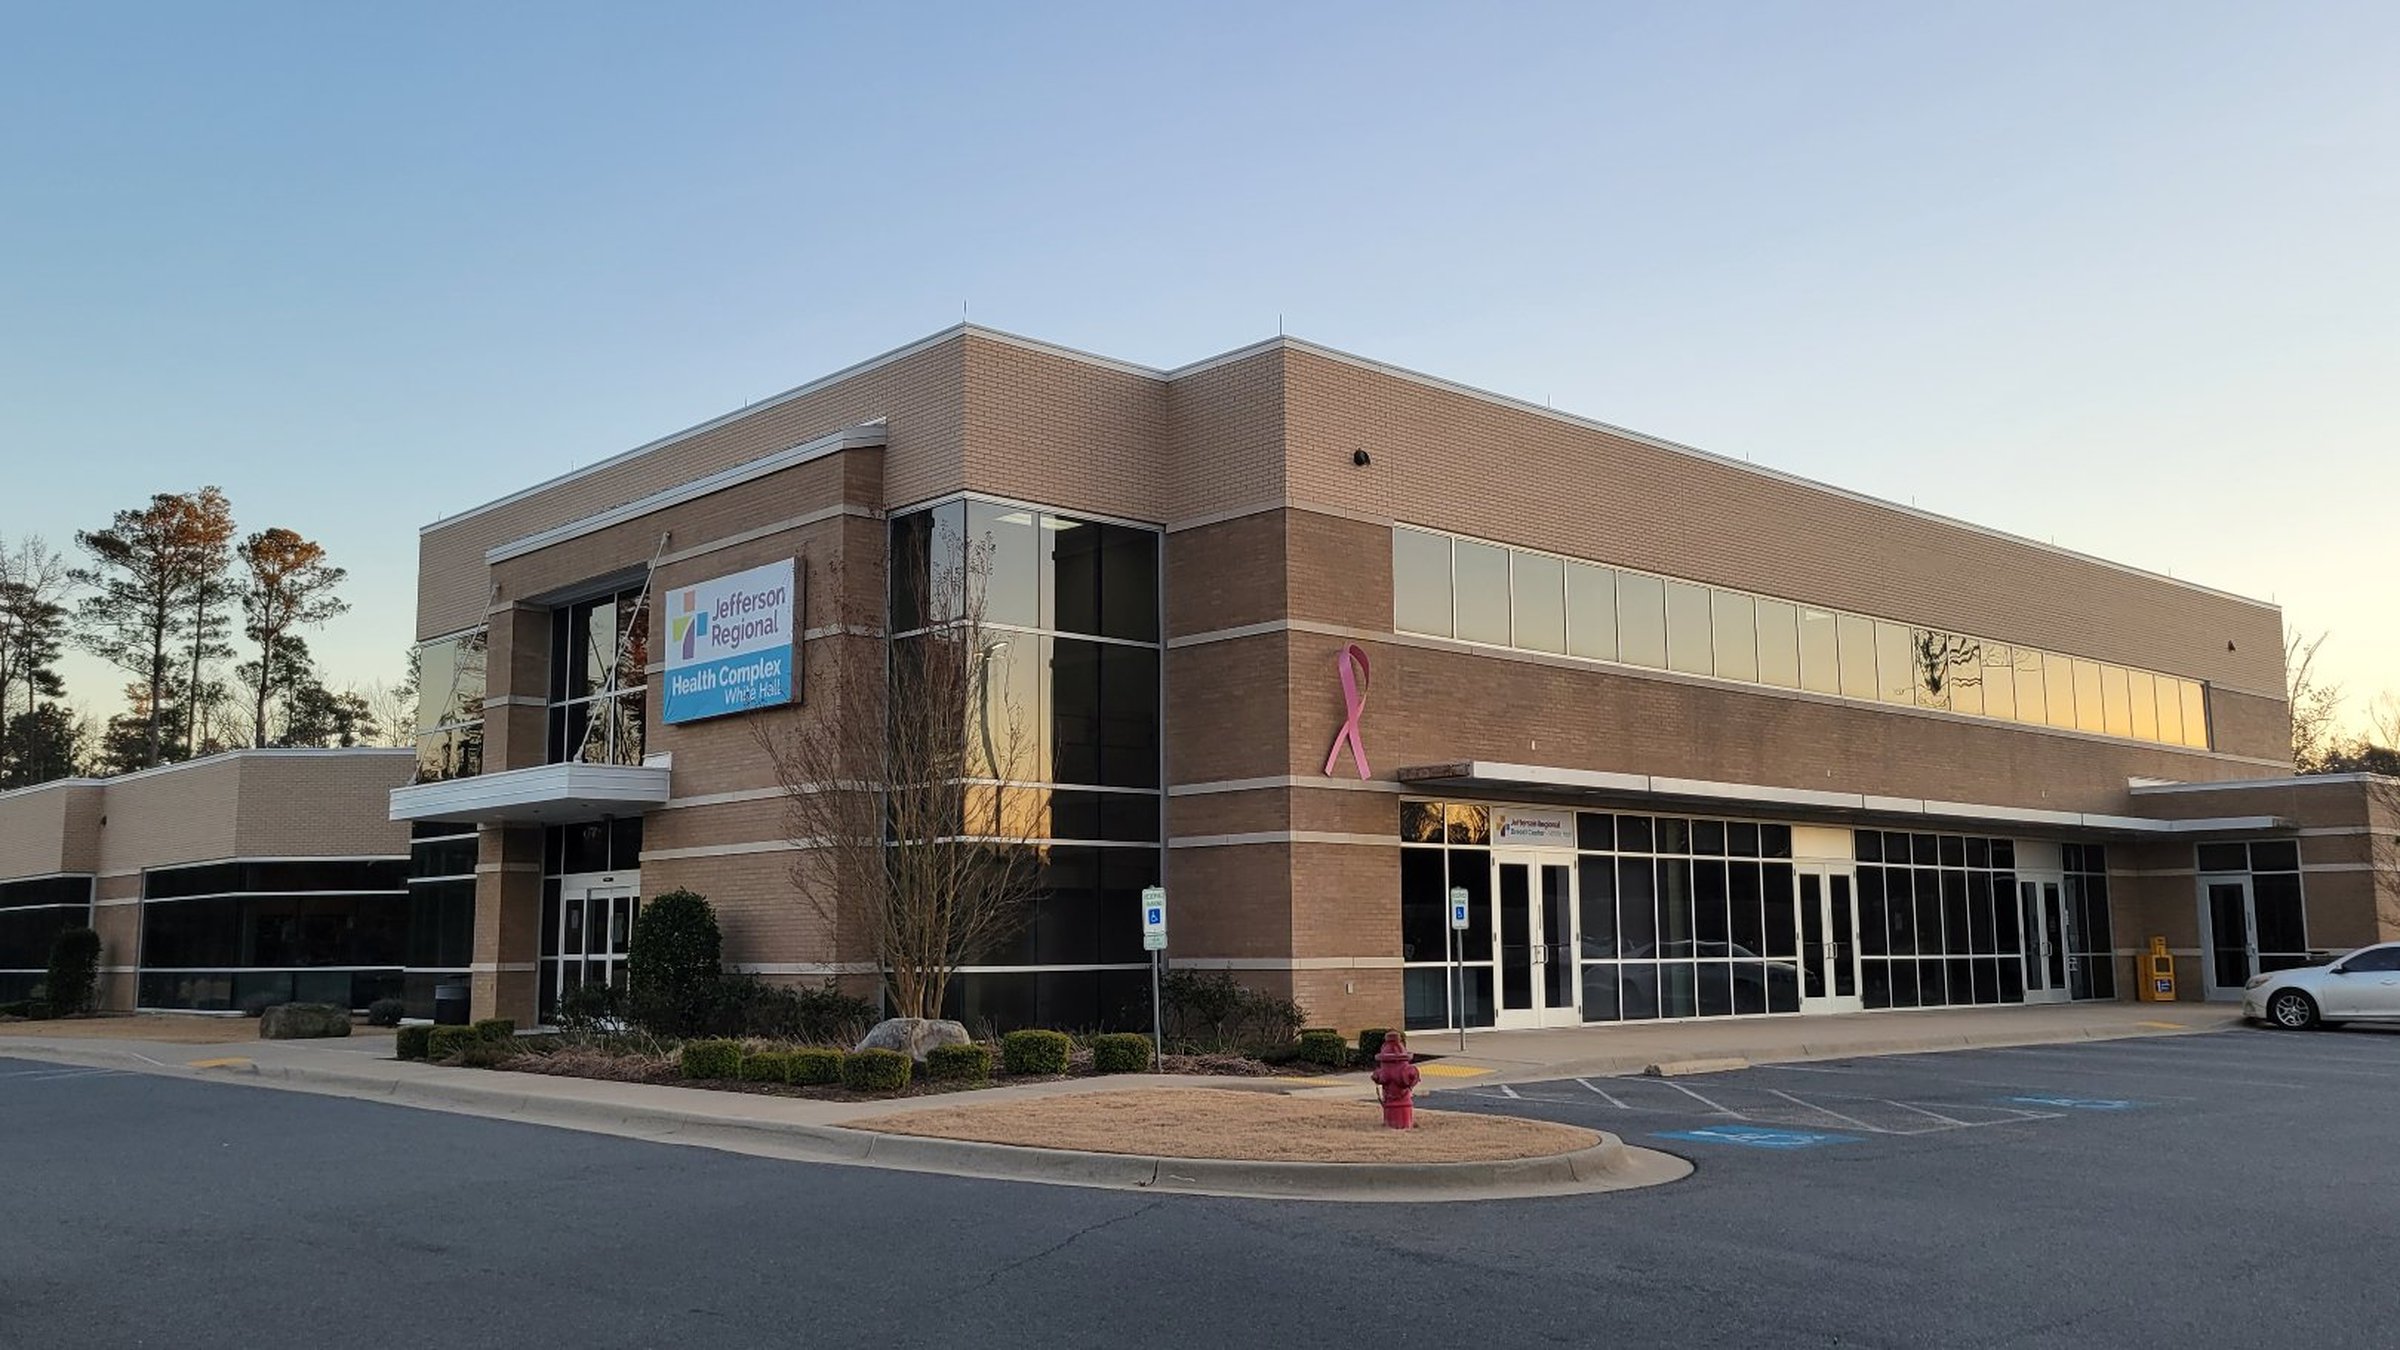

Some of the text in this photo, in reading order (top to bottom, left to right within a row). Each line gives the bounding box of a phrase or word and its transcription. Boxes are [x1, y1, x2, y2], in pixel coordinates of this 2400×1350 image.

[712, 587, 785, 621] Jefferson
[712, 610, 778, 648] Regional
[672, 657, 782, 696] Health Complex
[724, 679, 782, 705] White Hall
